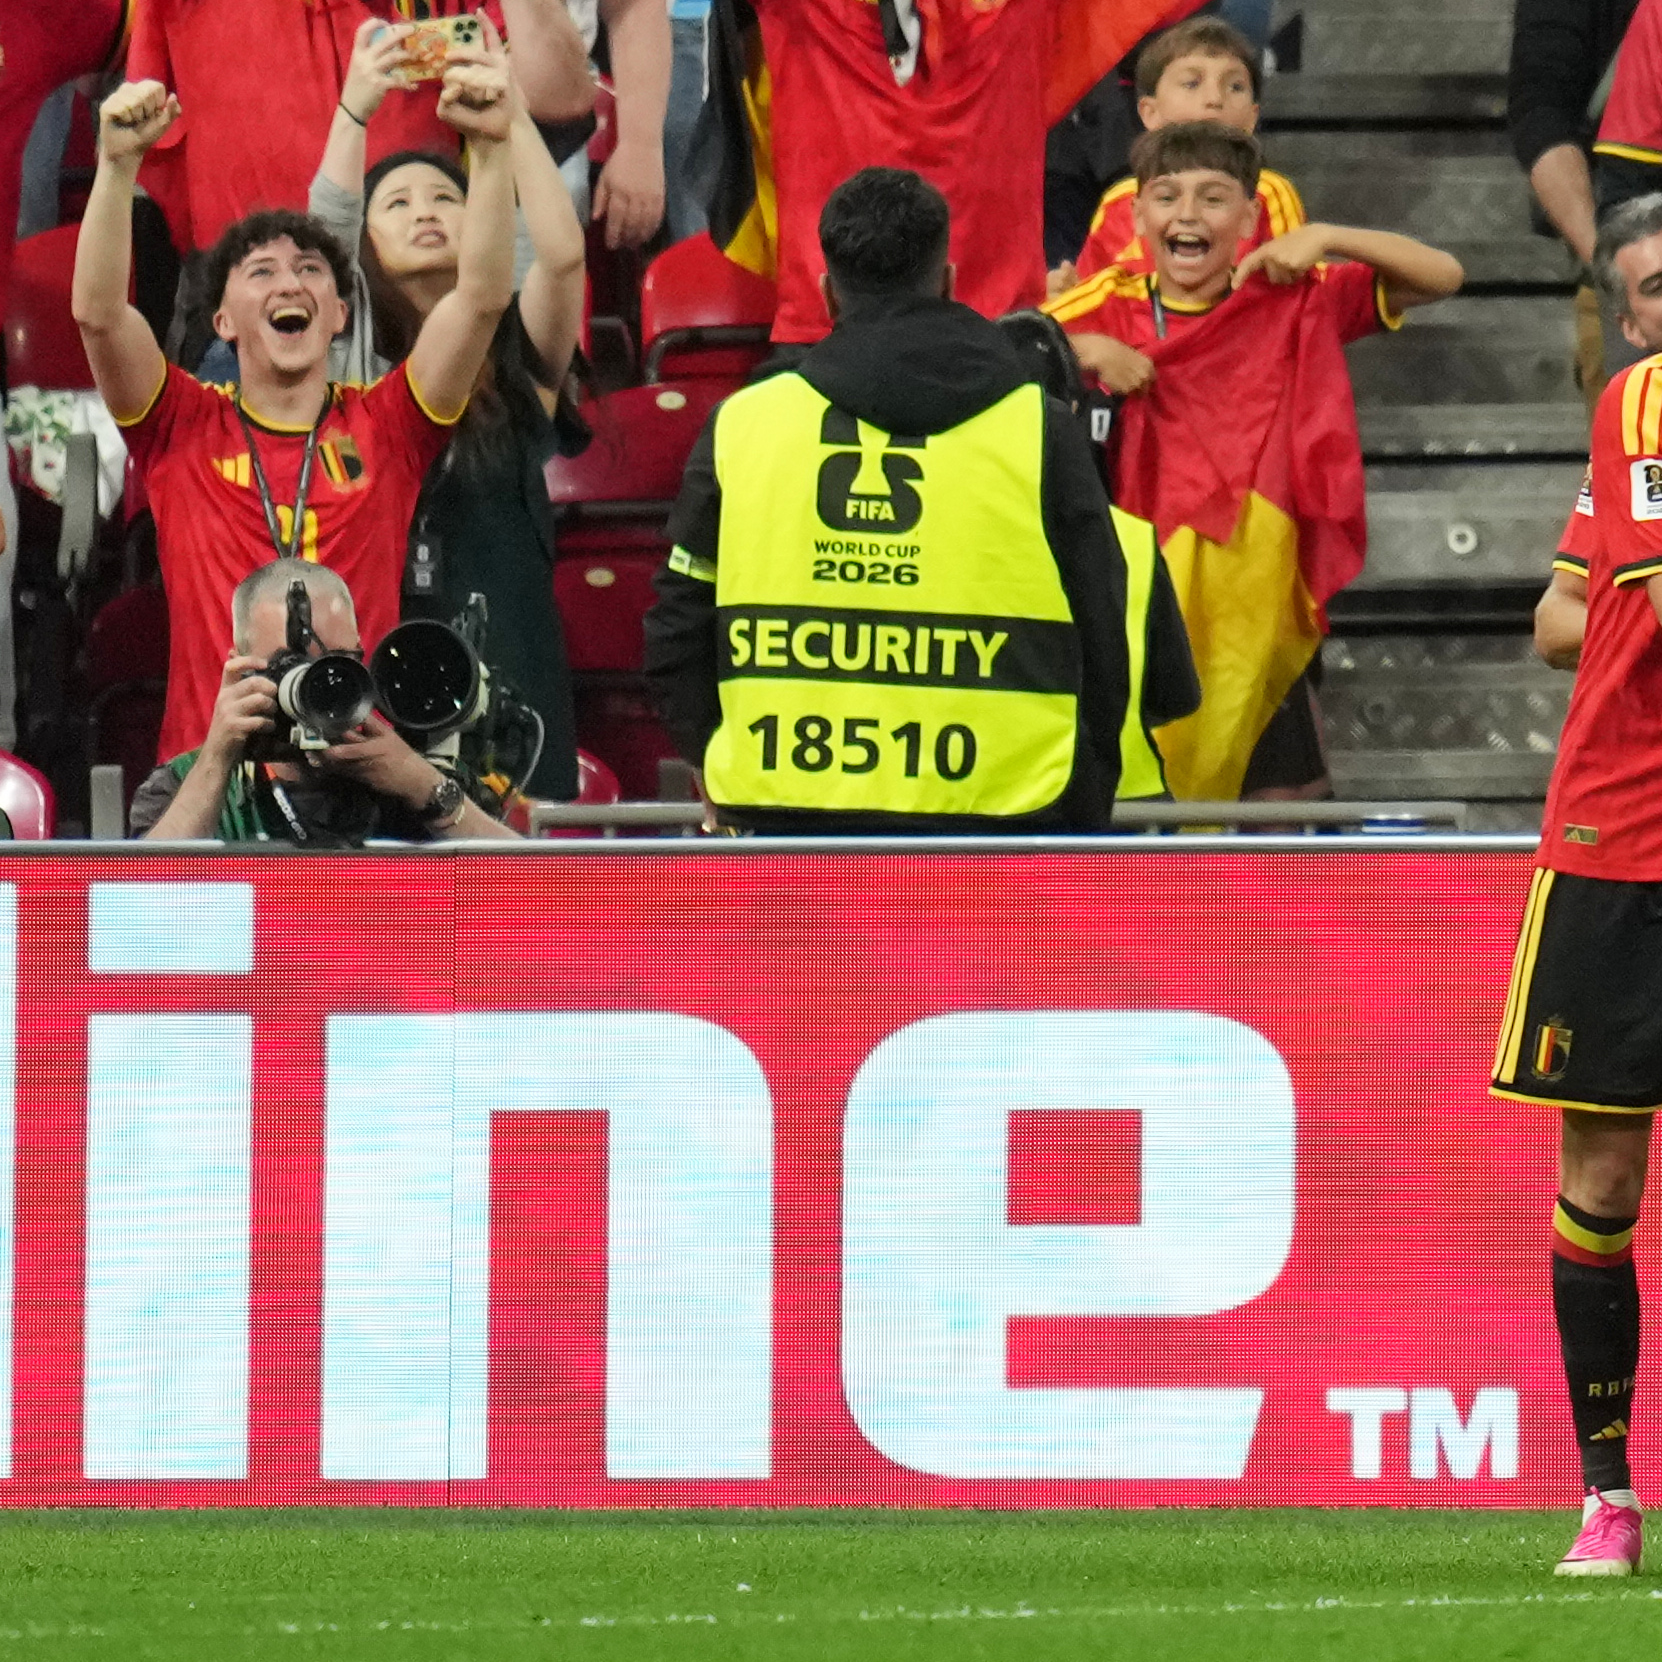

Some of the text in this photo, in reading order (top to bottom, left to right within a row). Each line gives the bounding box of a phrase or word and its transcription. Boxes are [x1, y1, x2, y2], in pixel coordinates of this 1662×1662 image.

[845, 499, 896, 521] FIFA
[814, 539, 921, 559] WORLD CUP
[812, 560, 920, 586] 2026
[729, 617, 1010, 678] SECURITY
[748, 713, 978, 782] 18510
[0, 882, 1520, 1480] ine TM
